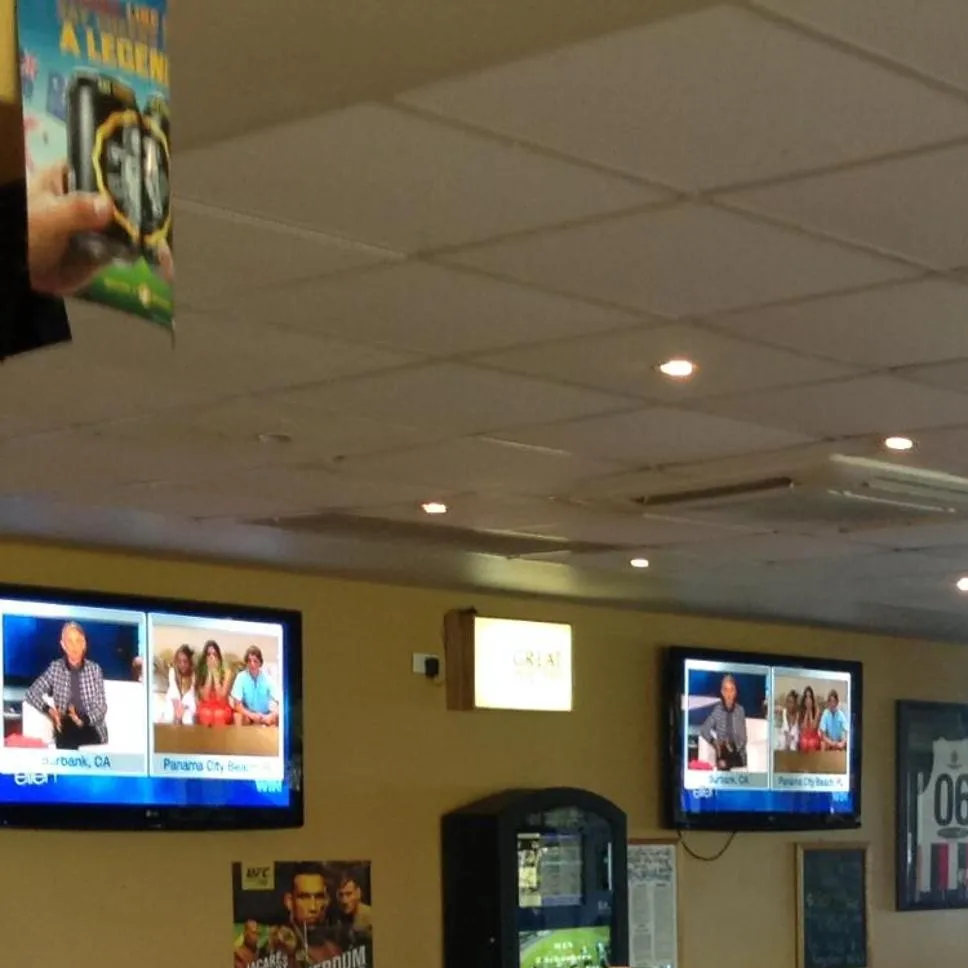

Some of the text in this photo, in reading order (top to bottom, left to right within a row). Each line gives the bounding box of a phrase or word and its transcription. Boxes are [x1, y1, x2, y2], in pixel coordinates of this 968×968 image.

[60, 20, 81, 58] A
[94, 756, 111, 768] CA
[164, 759, 203, 772] Panama
